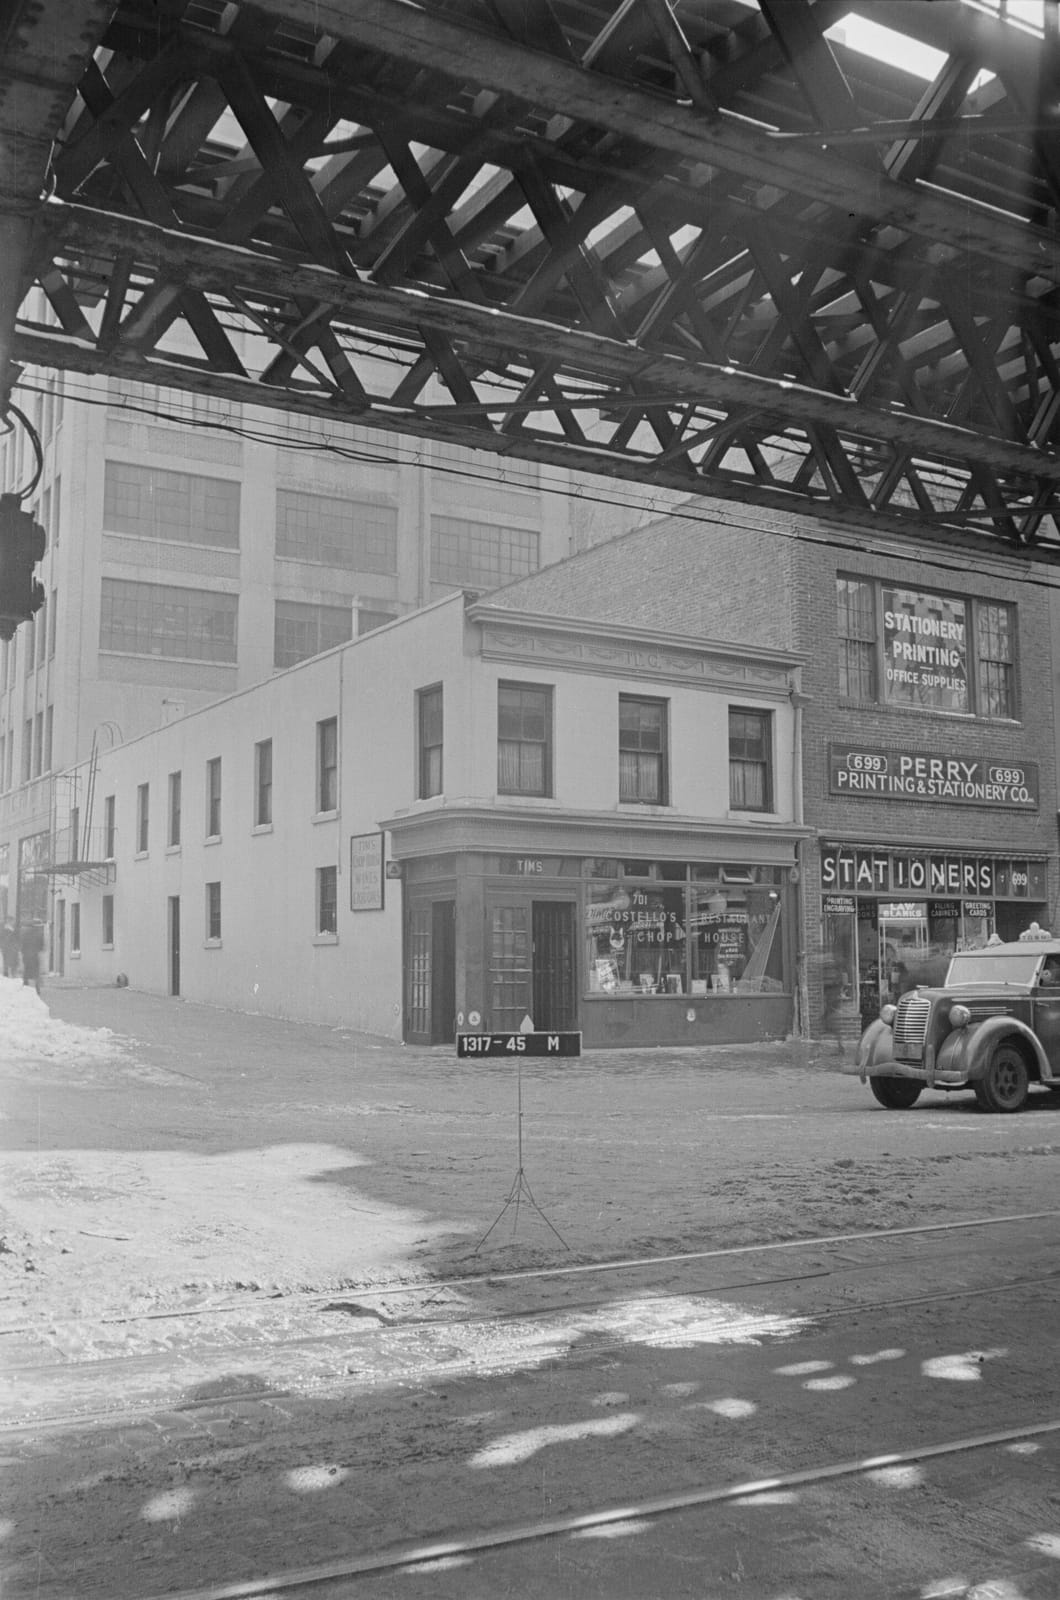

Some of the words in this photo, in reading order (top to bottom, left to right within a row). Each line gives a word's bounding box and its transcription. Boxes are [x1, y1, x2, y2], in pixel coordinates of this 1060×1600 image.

[884, 611, 964, 641] STATIONERY
[892, 641, 959, 667] PRINTING
[886, 668, 919, 685] OFFICE
[921, 674, 966, 692] SUPPLIES
[853, 756, 881, 770] 699
[900, 756, 978, 781] PERRY
[995, 770, 1021, 784] 699
[822, 858, 992, 888] STATIONERS
[1012, 872, 1027, 886] 699
[633, 895, 648, 905] 701
[965, 902, 991, 910] GREETING
[605, 911, 677, 923] COSTELLO'S
[637, 932, 673, 943] CHOP
[548, 1036, 560, 1051] M
